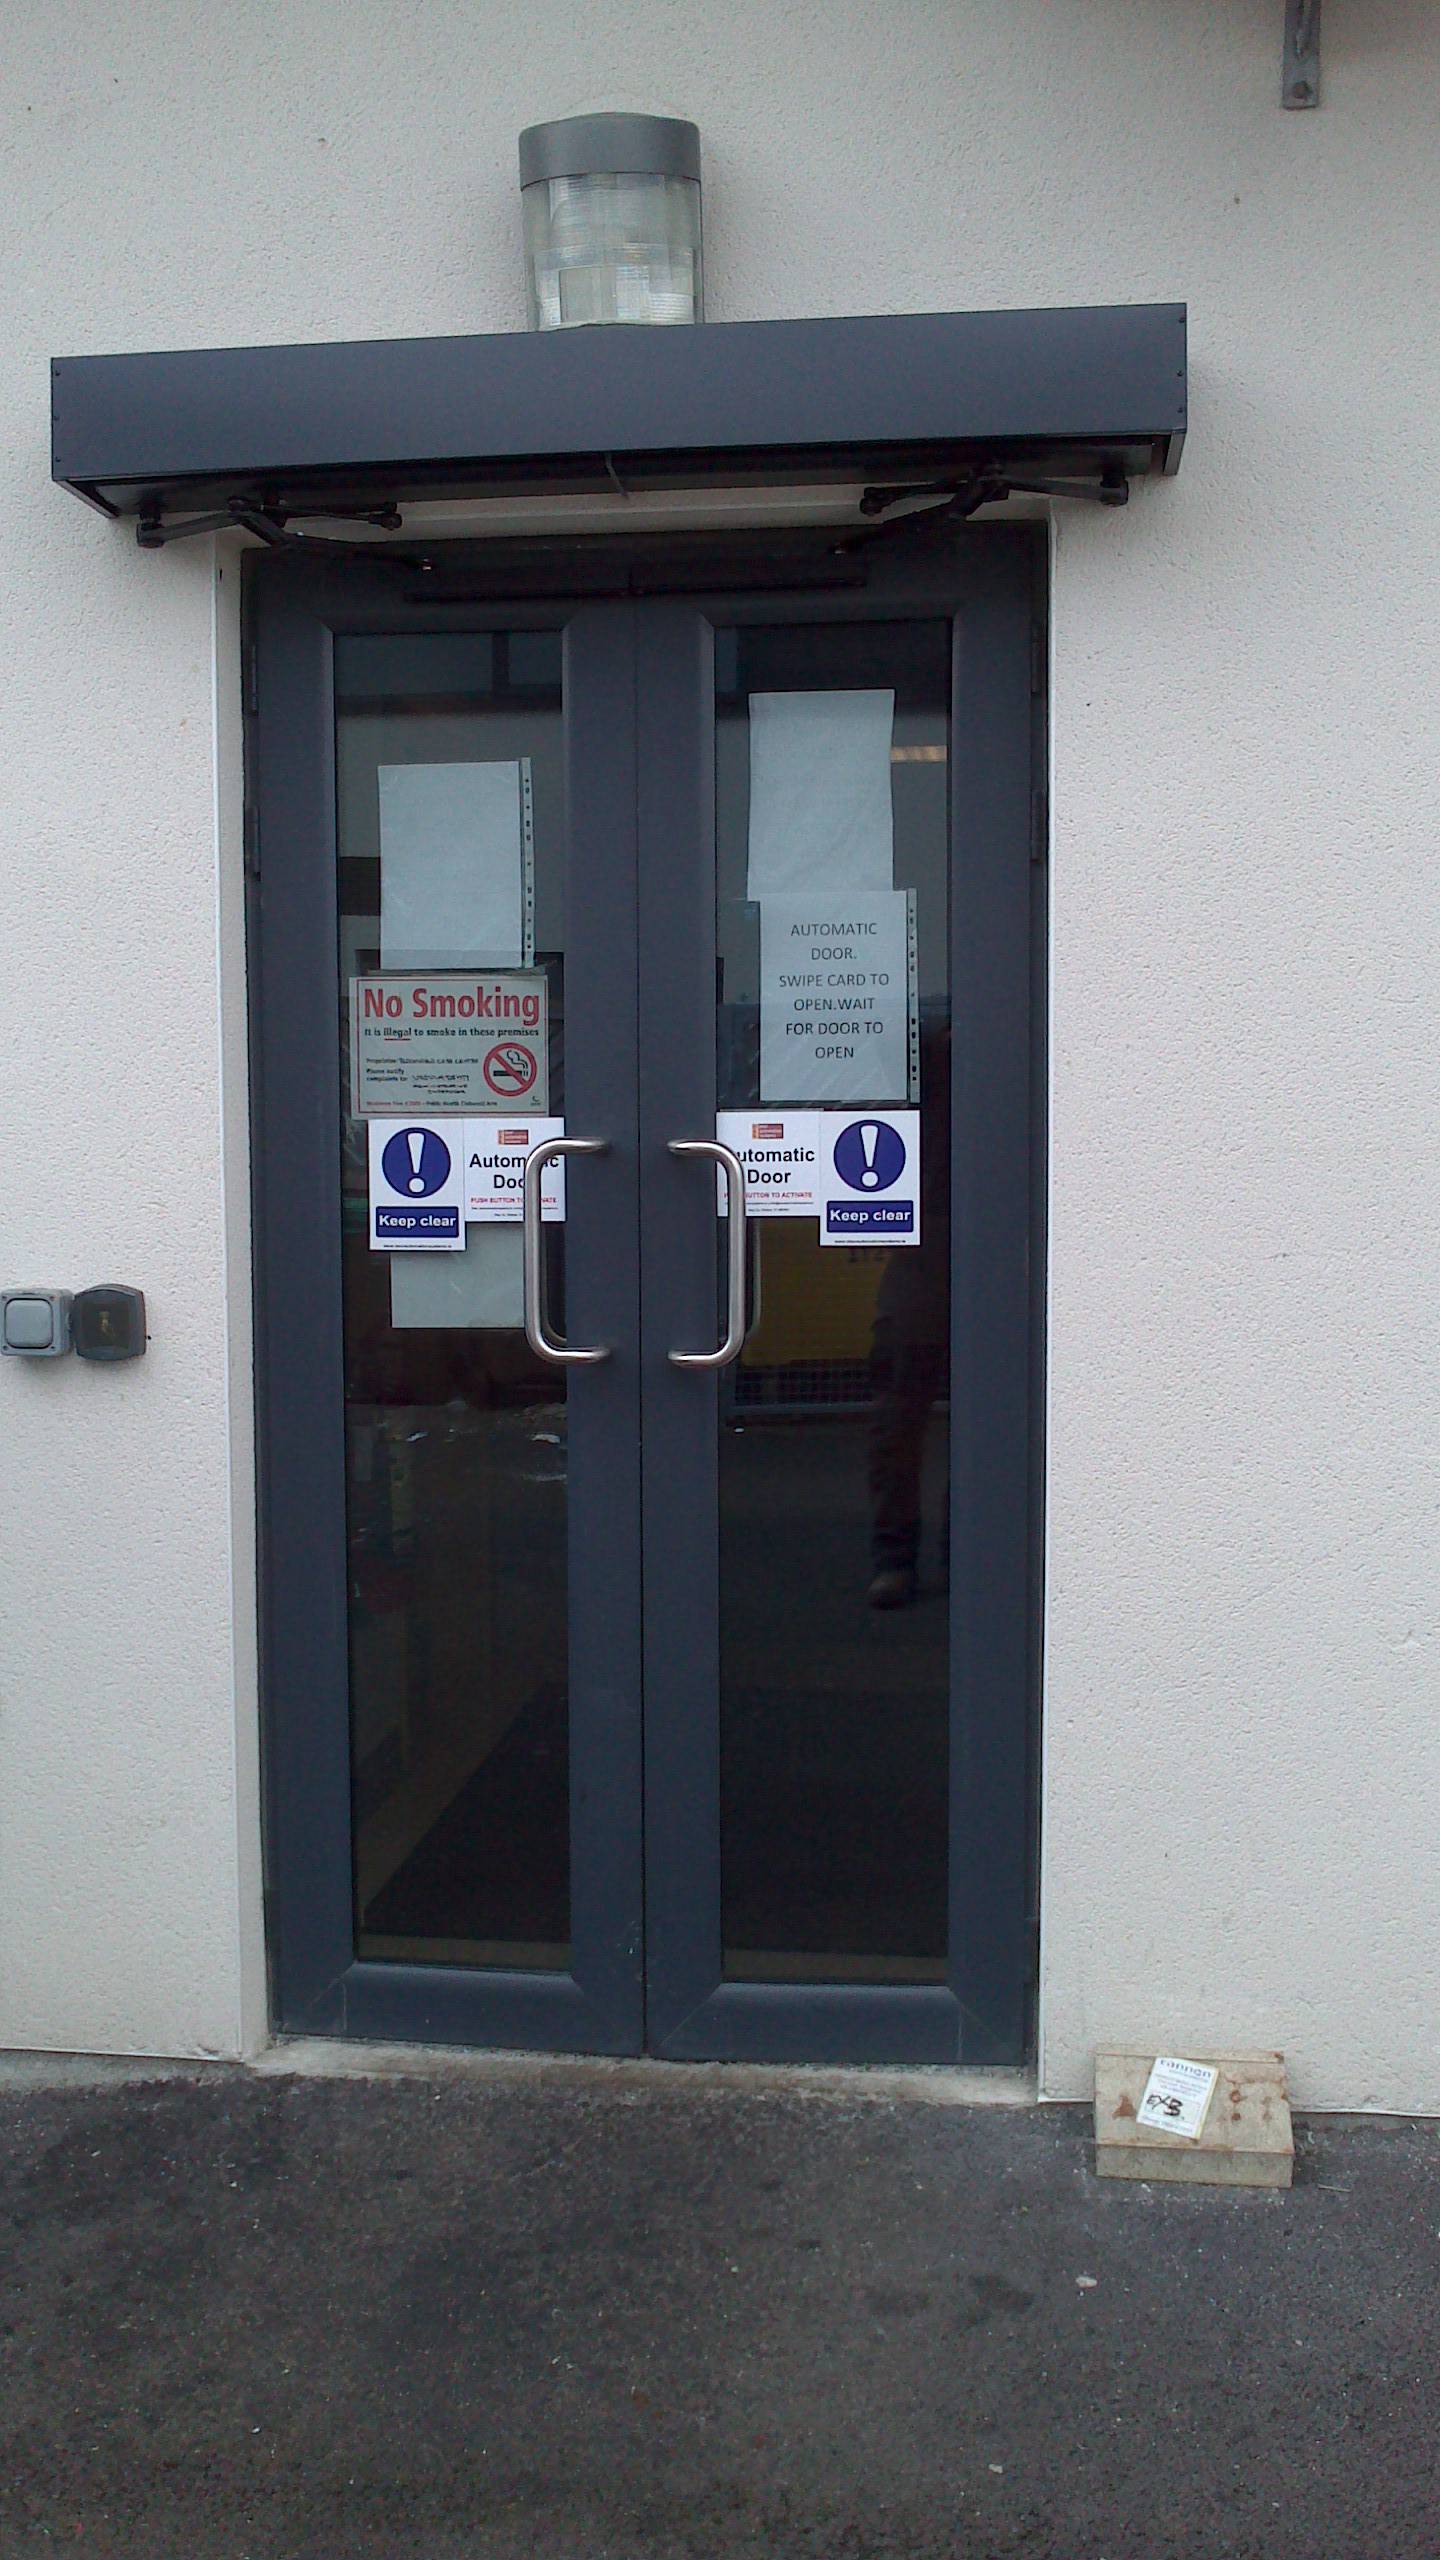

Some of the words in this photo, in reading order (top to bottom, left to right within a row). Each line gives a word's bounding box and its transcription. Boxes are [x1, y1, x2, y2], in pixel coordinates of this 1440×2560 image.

[790, 922, 878, 937] AUTOMATIC
[811, 947, 857, 961] DOOR.
[779, 974, 823, 988] SWIPE
[827, 974, 866, 987] CARD
[870, 973, 890, 986] TO
[364, 987, 404, 1019] No
[412, 985, 540, 1027] Smoking
[374, 1028, 382, 1037] is
[383, 1027, 412, 1038] illegal
[414, 1028, 425, 1037] to
[426, 1027, 457, 1037] smoke
[458, 1027, 468, 1037] in
[469, 1027, 496, 1037] these
[497, 1027, 540, 1038] premises
[785, 1023, 814, 1036] FOR
[818, 1022, 860, 1036] DOOR
[864, 1021, 884, 1035] TO
[814, 1046, 855, 1060] OPEN
[736, 1147, 815, 1163] utomatic
[493, 1174, 526, 1189] Doo
[747, 1169, 792, 1184] Door
[378, 1214, 417, 1229] Keep
[419, 1214, 457, 1228] clear
[829, 1208, 869, 1224] Keep
[872, 1209, 911, 1222] clear
